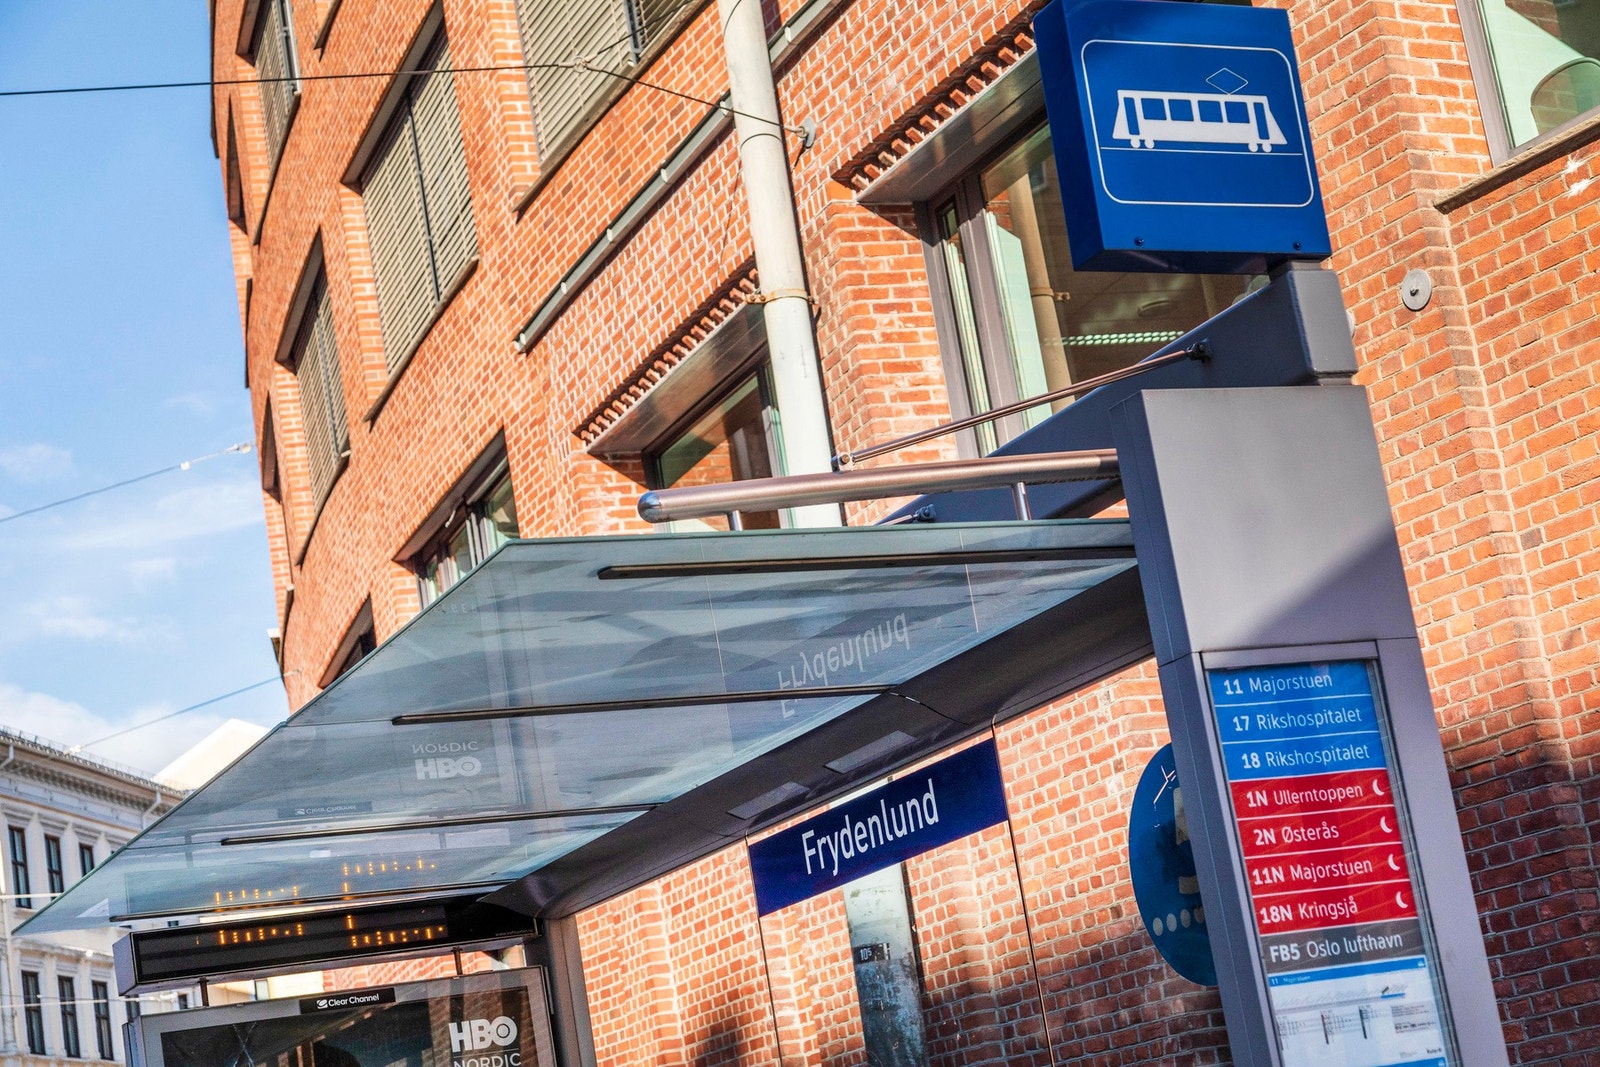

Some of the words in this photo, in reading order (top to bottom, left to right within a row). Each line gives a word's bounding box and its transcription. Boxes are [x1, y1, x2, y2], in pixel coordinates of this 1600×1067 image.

[1223, 679, 1243, 695] 11
[1249, 674, 1333, 696] Majorstuen
[1232, 716, 1250, 732] 17
[1257, 708, 1362, 730] Rikshospitalet
[1241, 752, 1261, 769] 18
[1265, 744, 1370, 768] Rikshospitalet
[1246, 790, 1269, 808] 1N
[1273, 784, 1363, 806] Ullerntoppen
[801, 778, 940, 877] Frydenlund
[1253, 829, 1276, 846] 2N
[1282, 822, 1340, 842] Østerås
[1252, 869, 1285, 886] 11N
[1289, 858, 1373, 884] Majorstuen
[1260, 905, 1294, 924] 18N
[1298, 896, 1358, 920] Kringsjå
[1269, 944, 1301, 963] FB5
[1306, 939, 1341, 958] Oslo
[1343, 933, 1403, 955] lufthavn
[328, 998, 349, 1007] Clear
[348, 993, 380, 1004] Channel
[448, 1015, 518, 1053] HBO
